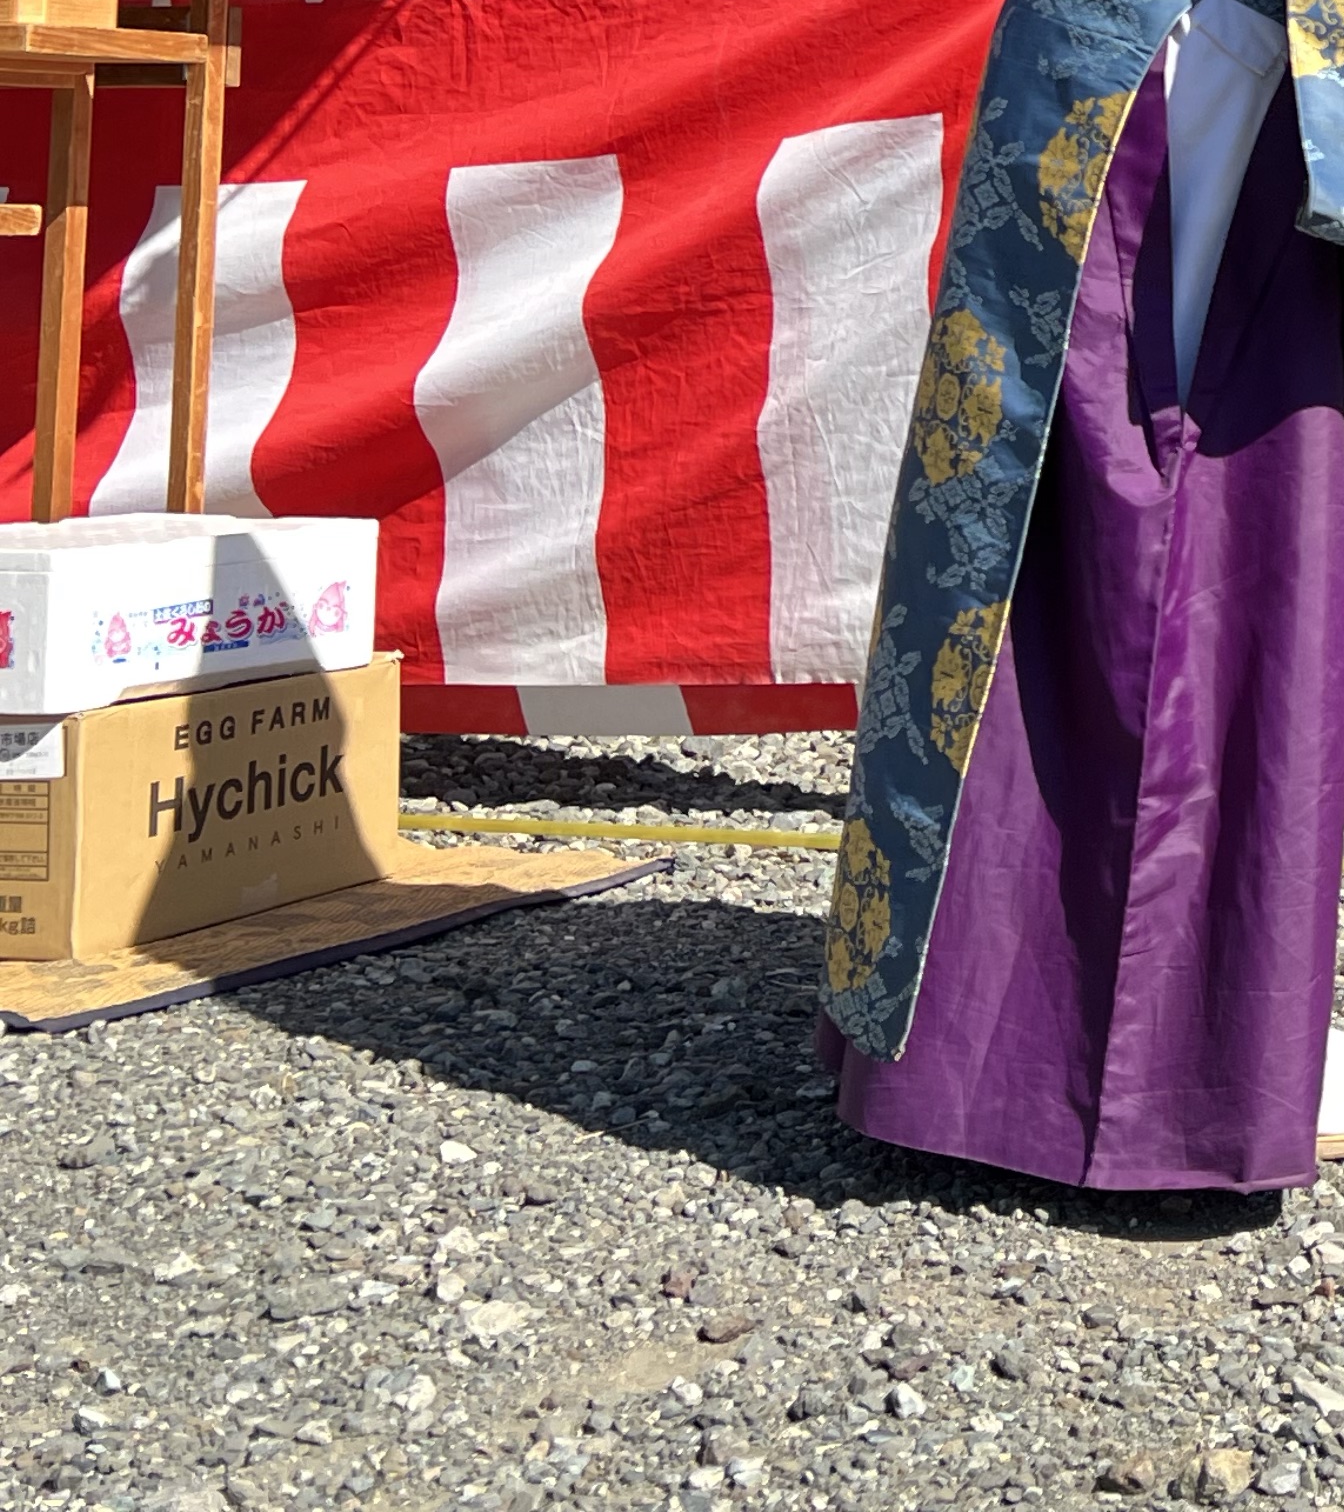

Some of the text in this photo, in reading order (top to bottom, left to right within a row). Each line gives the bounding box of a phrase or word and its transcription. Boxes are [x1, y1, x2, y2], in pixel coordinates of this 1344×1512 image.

[166, 601, 288, 647] みょうが
[174, 696, 330, 751] EGG FARM
[148, 744, 344, 843] Hychick
[155, 816, 339, 873] YAMANASHI
